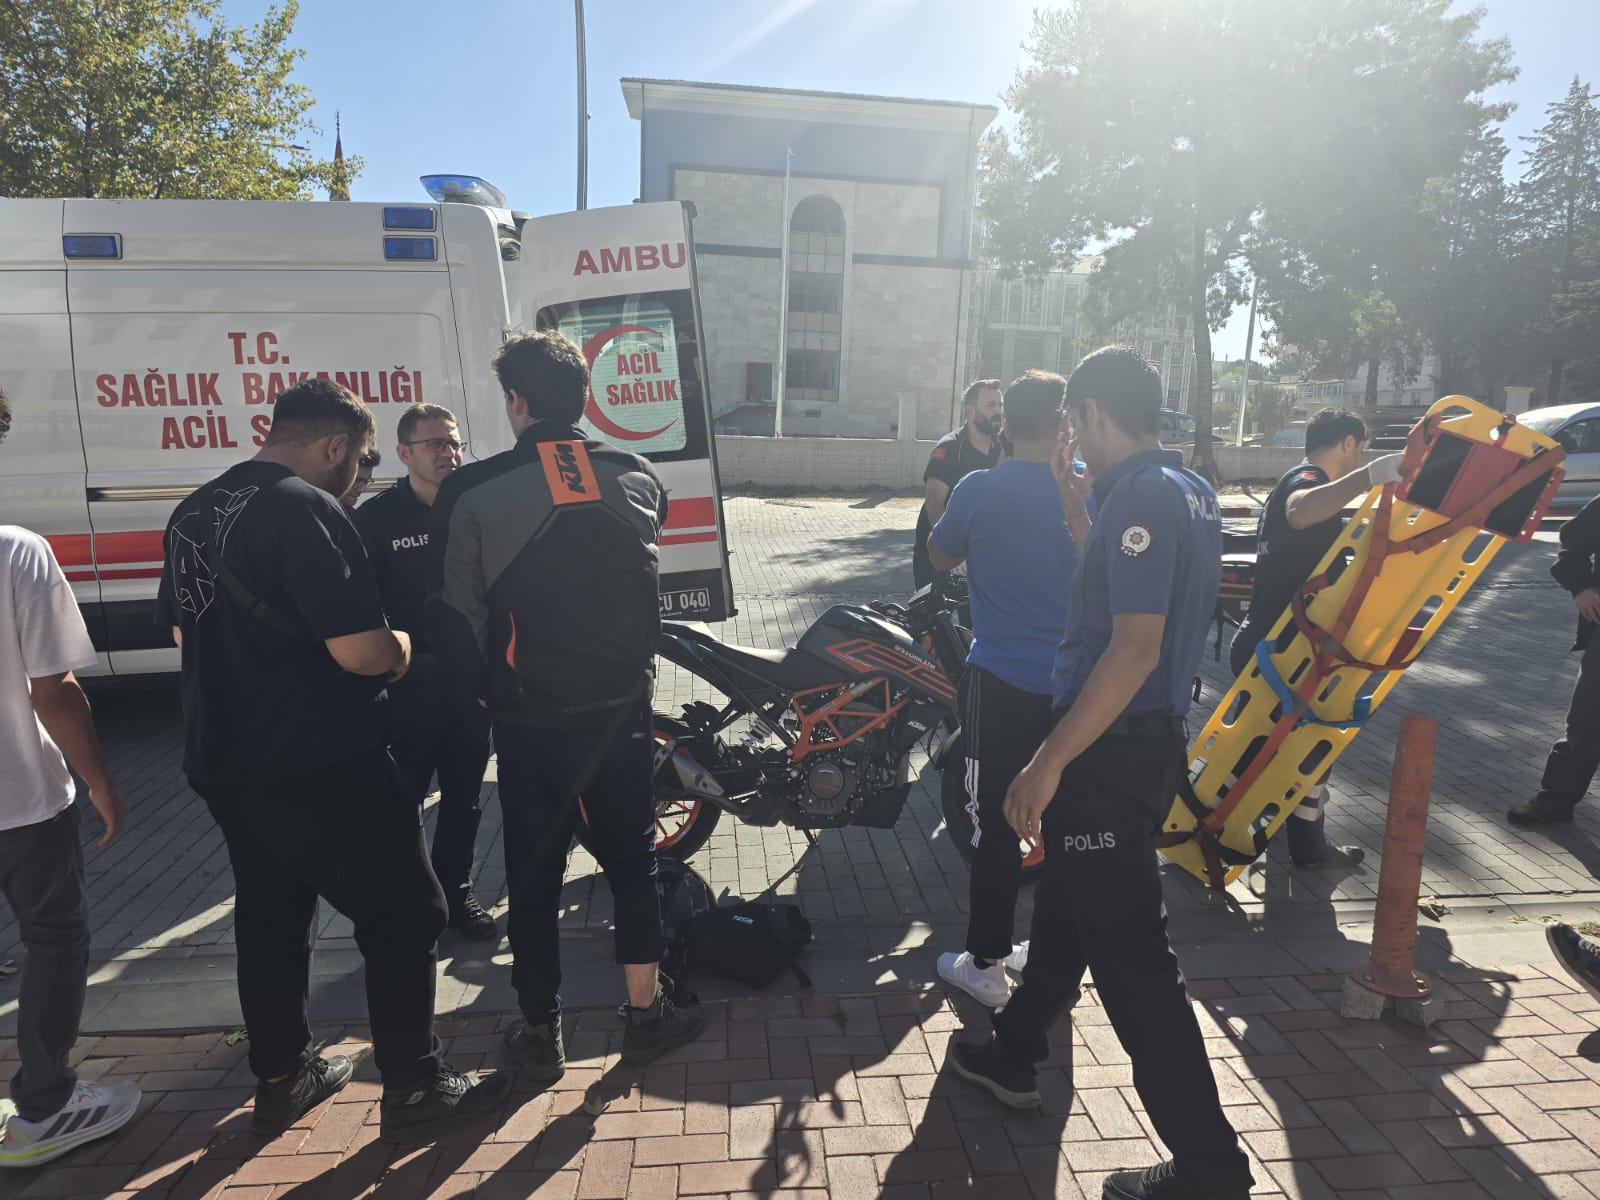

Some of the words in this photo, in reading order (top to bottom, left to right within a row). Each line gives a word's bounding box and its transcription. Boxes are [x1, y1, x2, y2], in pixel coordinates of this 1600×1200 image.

[228, 331, 290, 365] T.C.
[617, 346, 662, 376] ACİL
[96, 367, 223, 408] SAĞLIK
[606, 378, 679, 406] SAĞLIK
[161, 409, 238, 450] ACİL
[553, 443, 587, 495] KTM
[680, 591, 707, 609] 040
